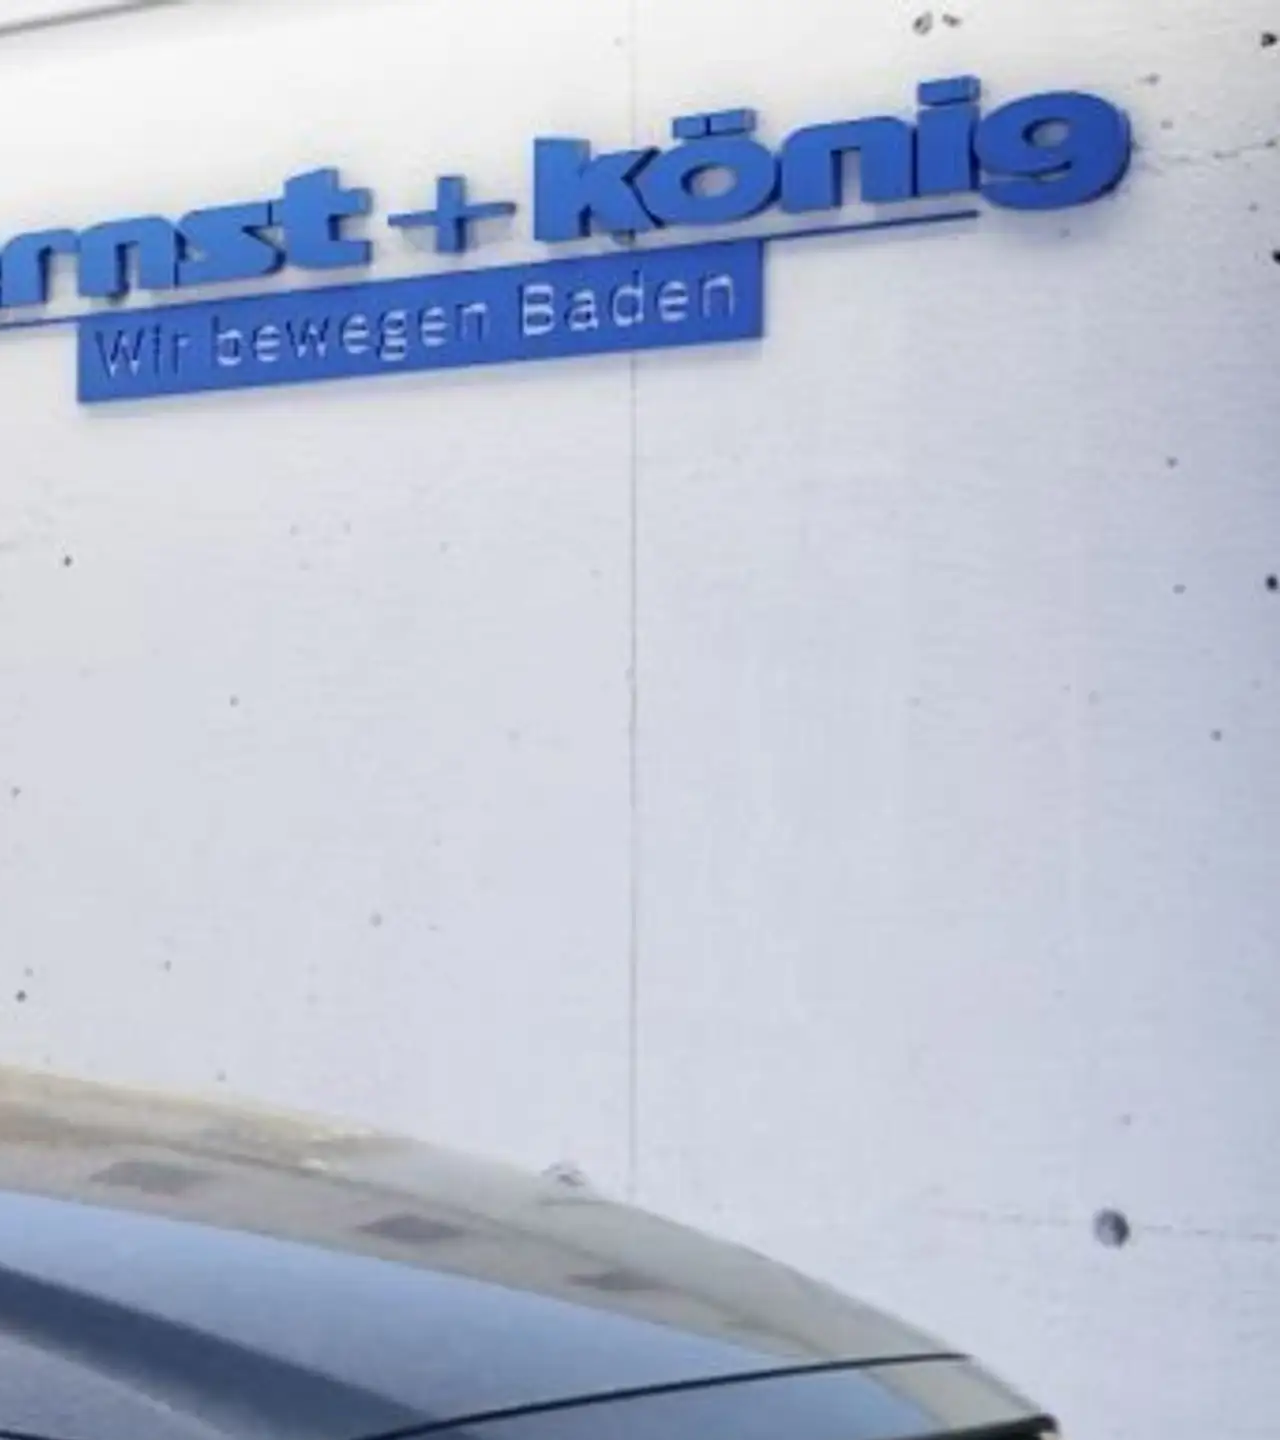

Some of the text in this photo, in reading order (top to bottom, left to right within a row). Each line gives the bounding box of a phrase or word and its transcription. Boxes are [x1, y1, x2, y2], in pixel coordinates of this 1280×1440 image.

[95, 267, 738, 379] Wir bewegen Baden
